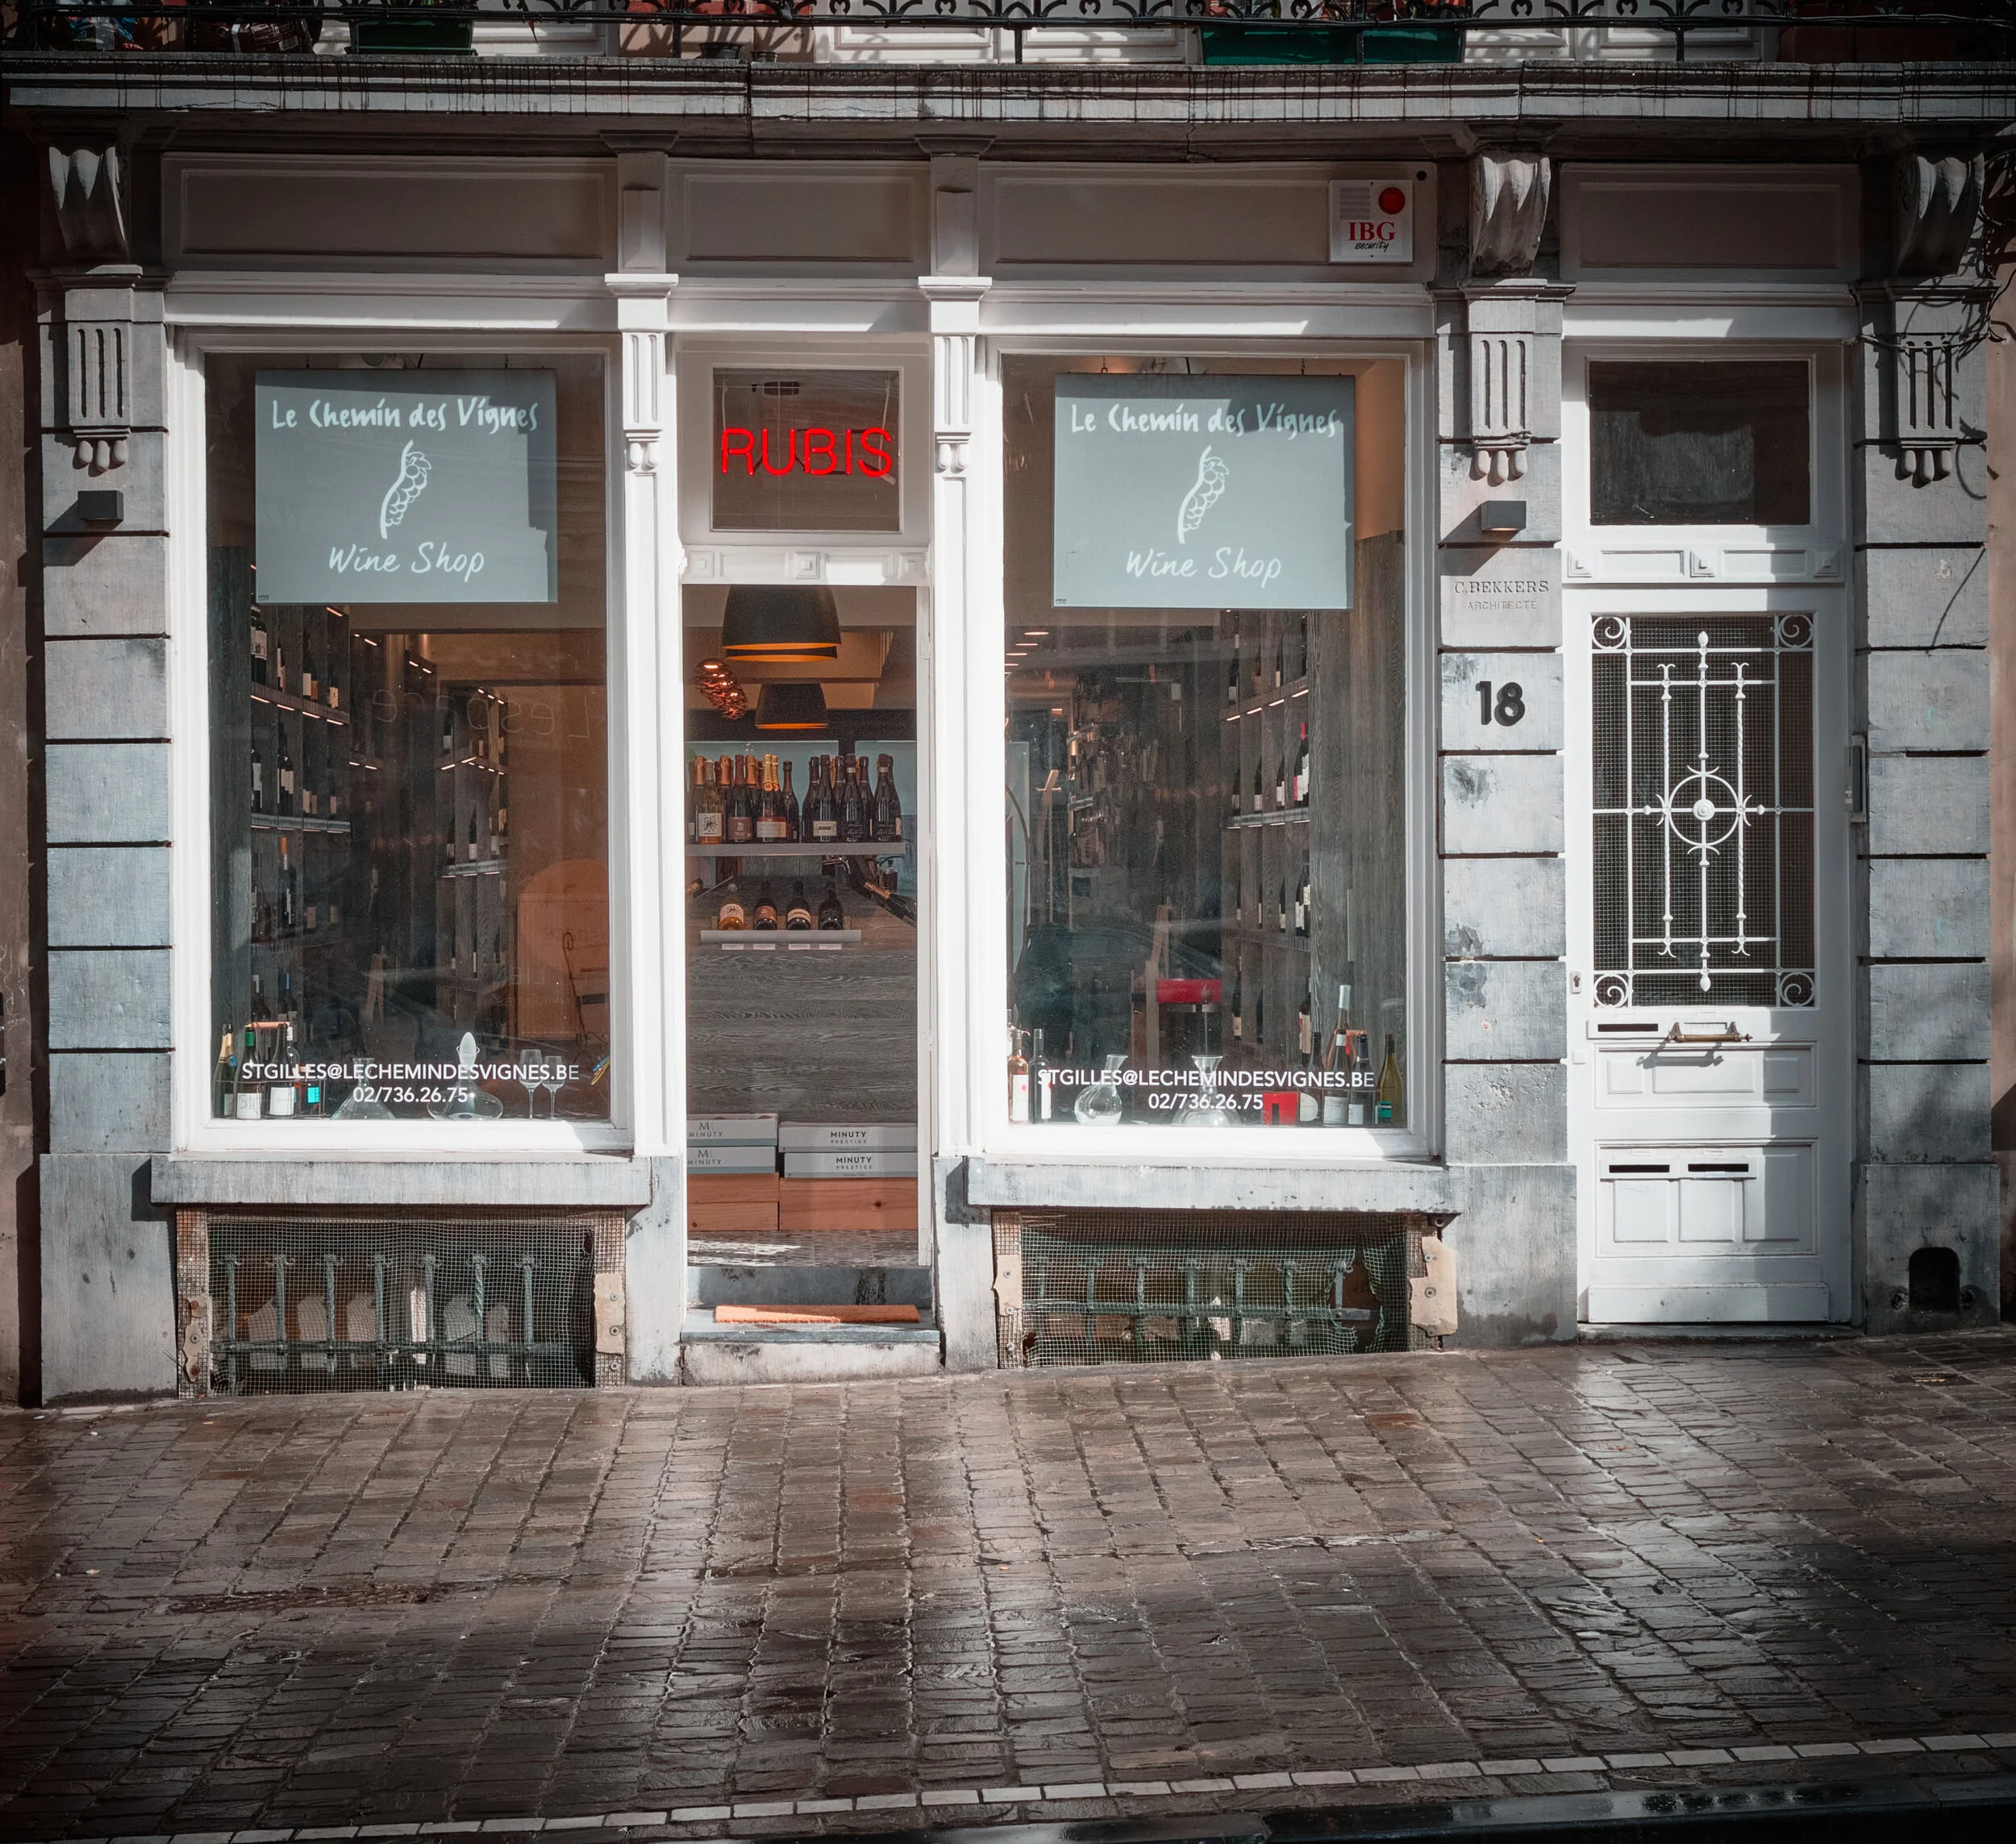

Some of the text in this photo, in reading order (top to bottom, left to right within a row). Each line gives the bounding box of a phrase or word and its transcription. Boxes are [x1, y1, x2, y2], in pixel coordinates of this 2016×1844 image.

[1348, 221, 1395, 241] IBG
[1355, 241, 1389, 252] security
[273, 397, 538, 434] Le Chemin des Vignes
[1072, 402, 1337, 439] Le Chemin des Vignes
[722, 427, 893, 477] RUBIS
[329, 541, 485, 583] Wine Shop
[1126, 547, 1281, 589] Wine Shop
[1467, 600, 1539, 610] ARCHITECTE
[1475, 681, 1526, 727] 18
[241, 1063, 580, 1080] STGILLES@LECHEMINDESVIGNES.BE
[1037, 1069, 1375, 1088] STGILLES@LECHEMINDESVIGNES.BE
[352, 1086, 469, 1105] 02/736.26.75
[1148, 1093, 1264, 1112] 02/736.26.75
